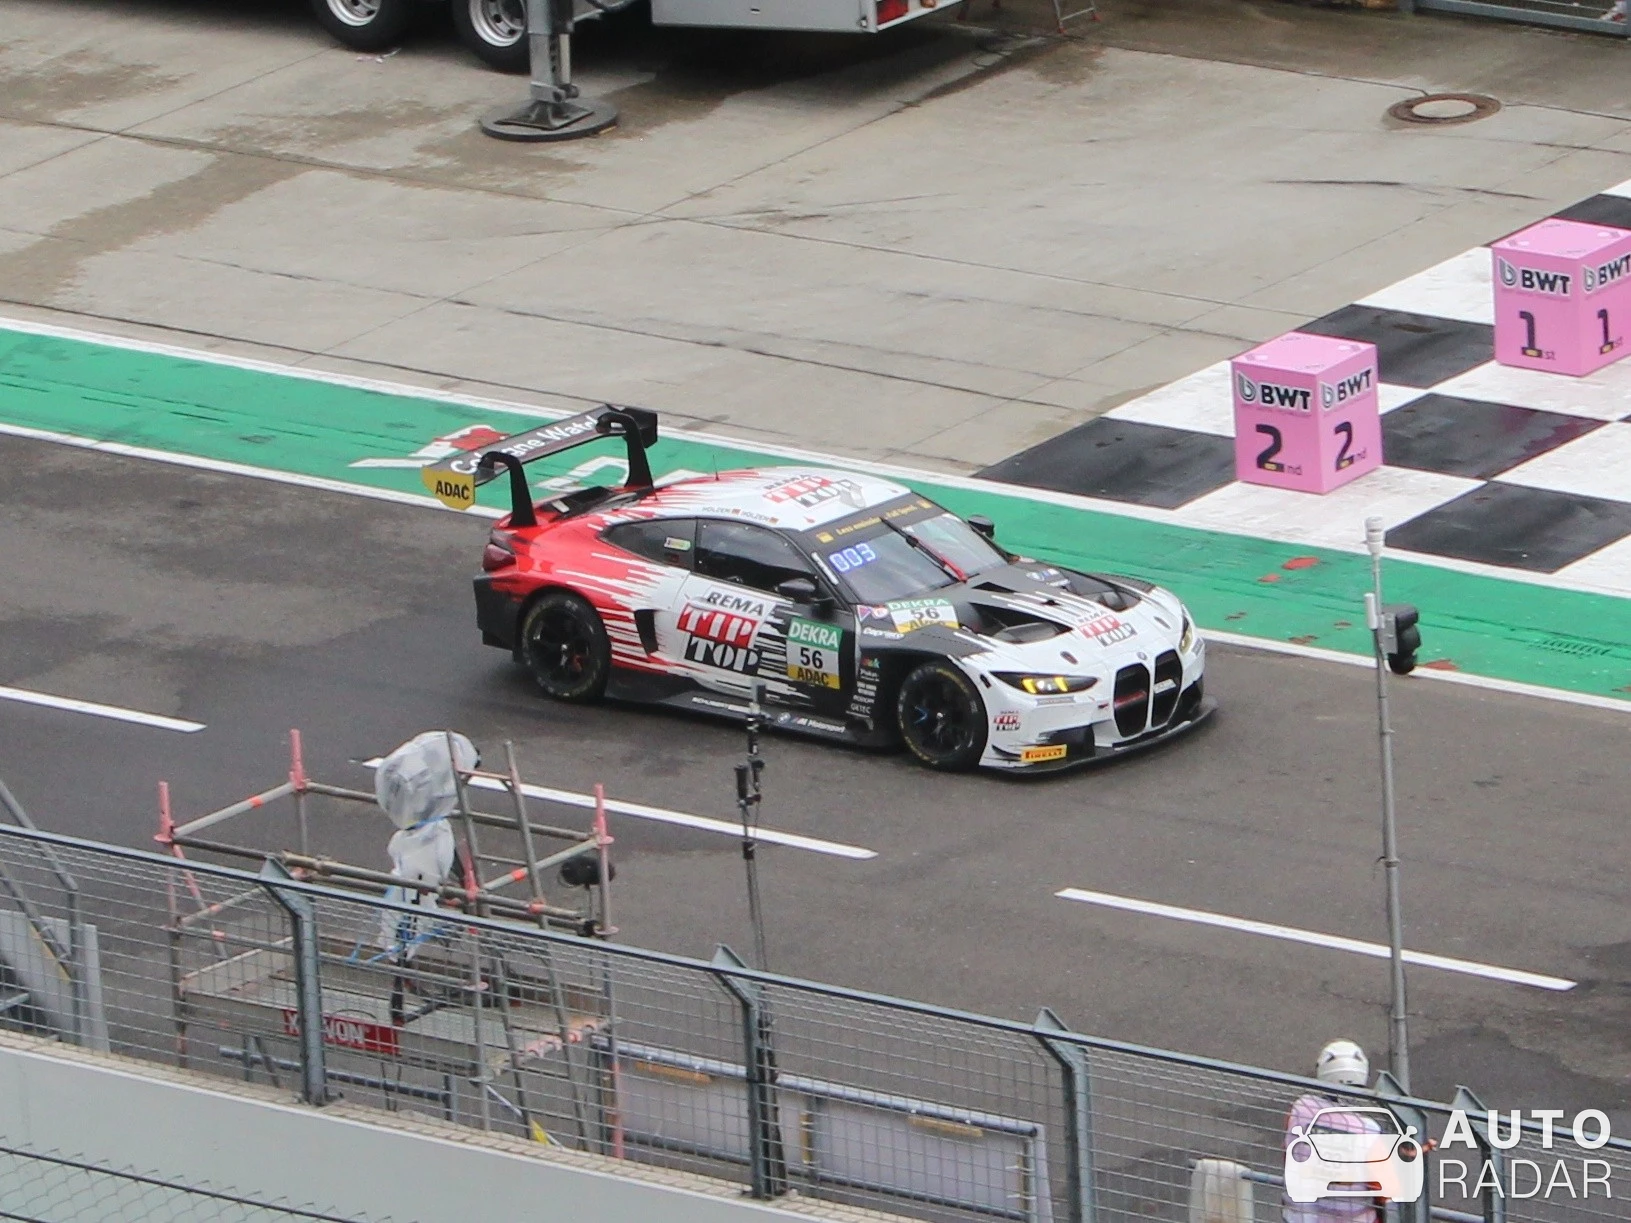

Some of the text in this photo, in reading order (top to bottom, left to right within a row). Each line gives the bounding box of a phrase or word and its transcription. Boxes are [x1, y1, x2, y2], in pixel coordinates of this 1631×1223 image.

[1521, 269, 1571, 295] BWT
[1598, 254, 1631, 286] BWT
[1260, 384, 1312, 410] BWT
[1337, 369, 1372, 402] BWT
[435, 479, 470, 500] ADAC
[829, 542, 876, 574] 003
[706, 591, 764, 617] REMA
[887, 598, 948, 611] DEKRA
[910, 607, 940, 620] 56
[680, 604, 756, 647] TIP
[788, 621, 839, 648] DEKRA
[686, 635, 759, 673] TOP
[799, 647, 824, 669] 56
[796, 667, 829, 686] ADAC
